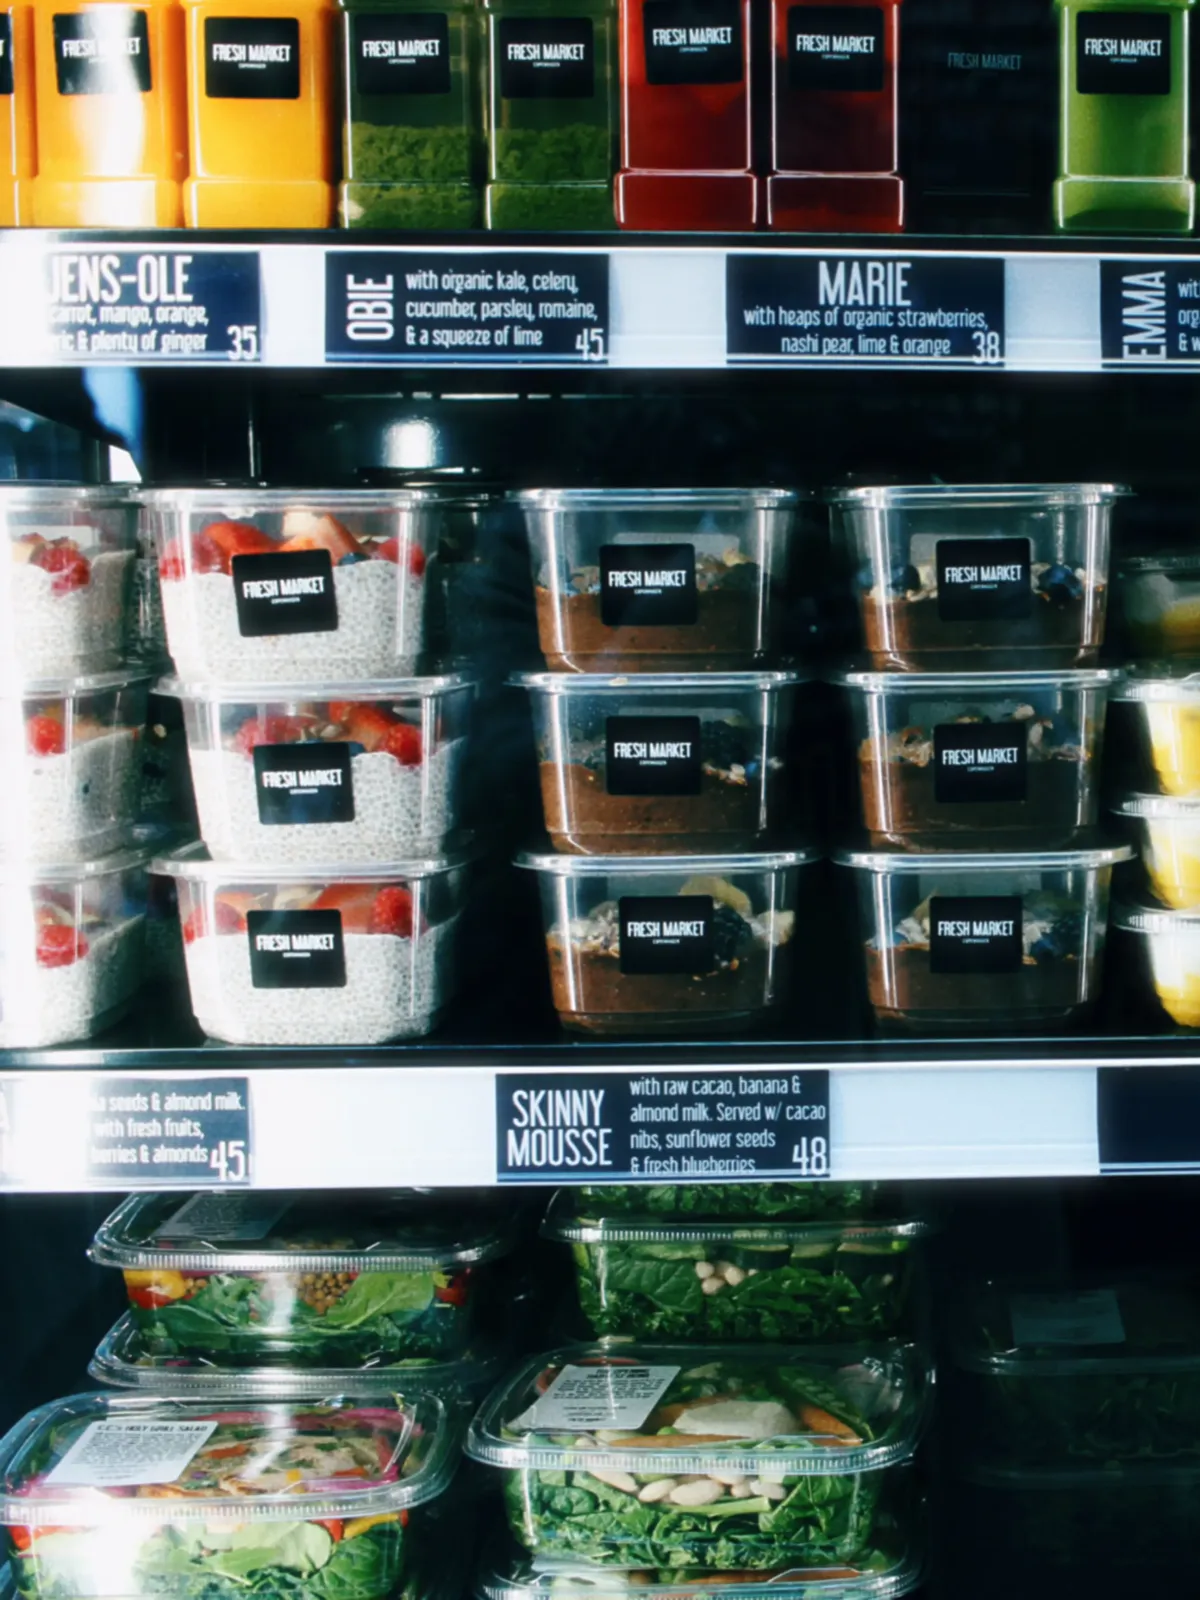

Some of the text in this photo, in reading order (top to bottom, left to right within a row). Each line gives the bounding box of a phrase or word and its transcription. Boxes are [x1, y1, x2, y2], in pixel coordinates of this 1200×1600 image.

[653, 27, 732, 45] FRESH MARKET
[1085, 39, 1162, 56] FRESH MARKET
[213, 44, 290, 62] FRESH MARKET
[363, 39, 440, 57] FRESH MARKET
[51, 254, 193, 302] JENS-OLE
[406, 269, 579, 294] with organic kale, celery,
[818, 261, 912, 306] MARIE
[100, 305, 208, 328] mango, orange,
[347, 274, 394, 341] OBIE
[406, 299, 598, 321] cucumber, parsley, romaine,
[744, 306, 988, 330] with heaps organic strawberries,
[1122, 271, 1166, 360] EMMA
[90, 330, 207, 354] plenty ginger
[227, 325, 257, 361] 35
[432, 326, 543, 348] squeeze lime
[576, 328, 604, 361] 45
[782, 334, 951, 357] nashi pear, lime orange
[972, 331, 1000, 364] 38
[243, 576, 324, 599] FRESH MARKET
[608, 570, 687, 587] FRESH MARKET
[942, 748, 1018, 765] FRESH MARKET
[262, 769, 342, 788] FRESH MARKET
[629, 1076, 788, 1098] with raw cacao, banana
[110, 1092, 245, 1112] seeds almond milk.
[512, 1089, 605, 1127] SKINNY
[630, 1101, 826, 1123] almond milk. Served w/ cacao
[128, 1118, 205, 1139] fresh fruits,
[630, 1128, 776, 1151] nibs, sunflower seeds
[153, 1144, 208, 1163] almonds
[507, 1128, 612, 1167] MOUSSE
[792, 1136, 826, 1176] 48
[210, 1140, 245, 1182] 45
[643, 1155, 756, 1175] fresh blueberries
